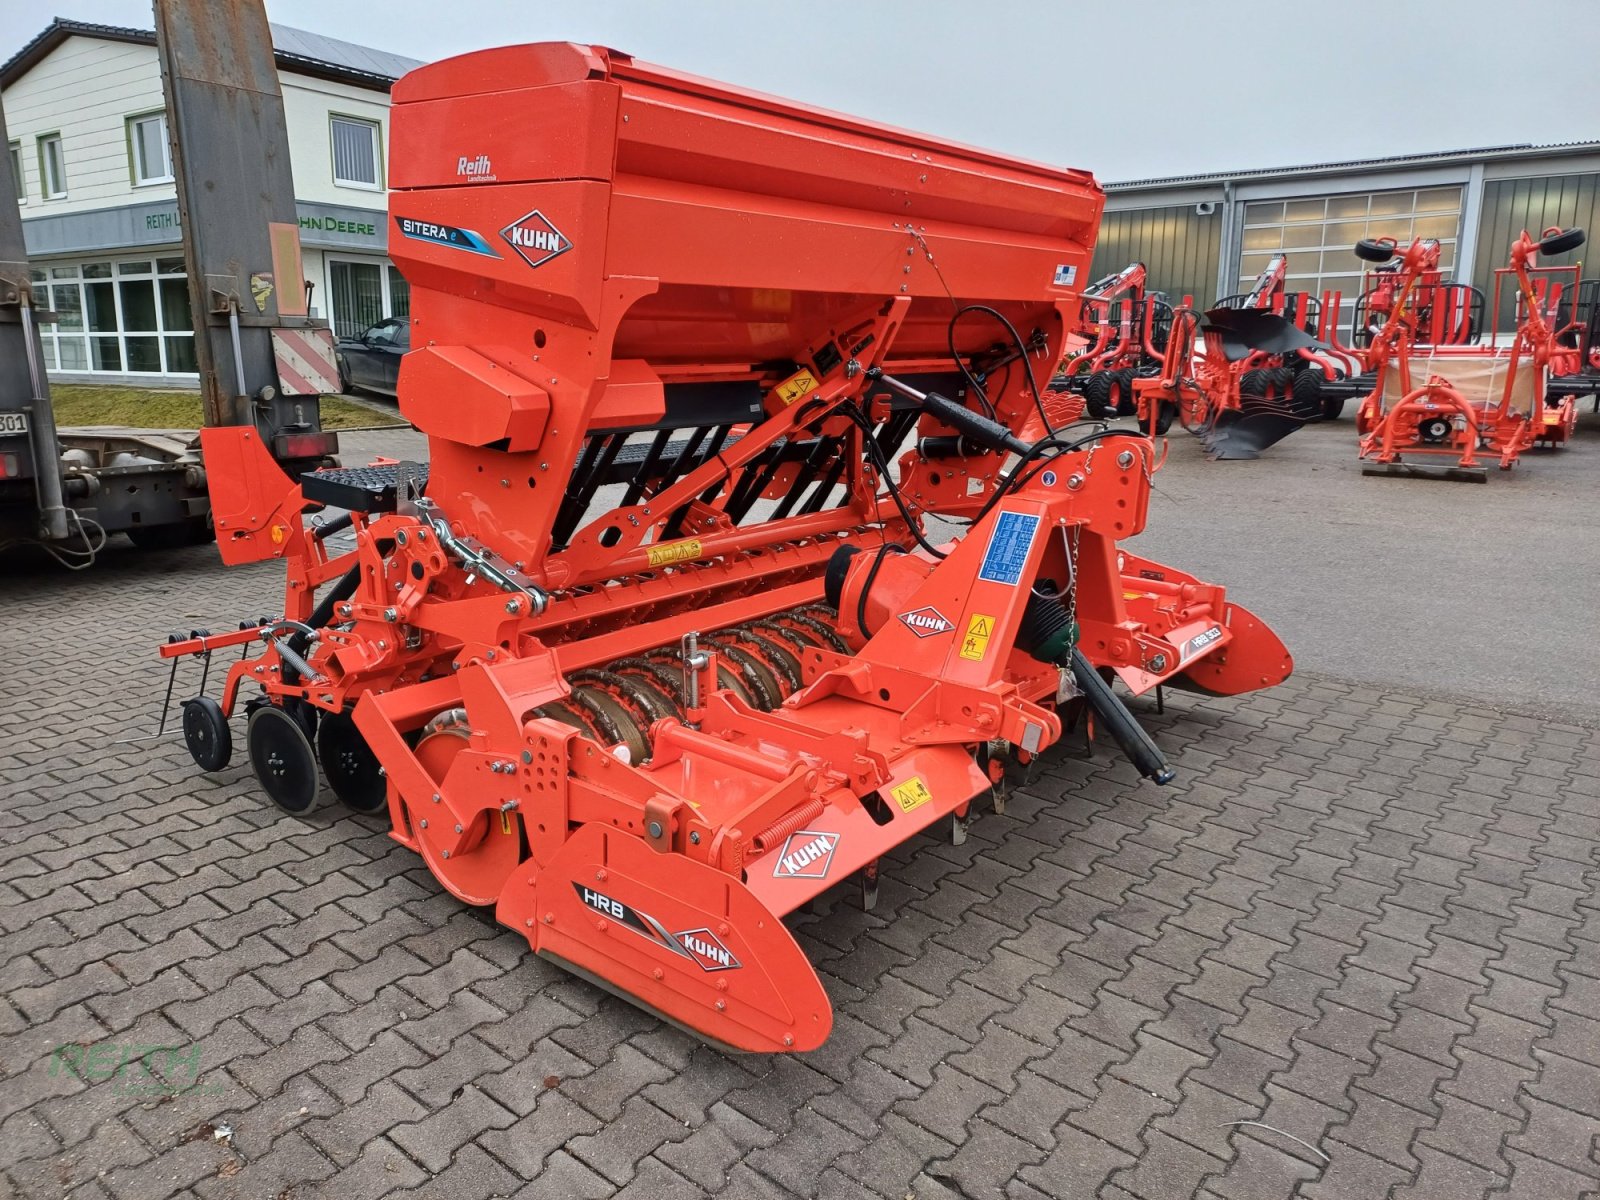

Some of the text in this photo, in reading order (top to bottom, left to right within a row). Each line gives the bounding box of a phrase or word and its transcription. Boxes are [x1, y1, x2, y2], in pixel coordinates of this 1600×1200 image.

[457, 155, 491, 176] Reith
[146, 213, 172, 230] REITH
[325, 216, 375, 236] DEERE
[403, 219, 448, 240] SITERA
[512, 226, 561, 252] KUHN
[906, 613, 948, 632] KUHN
[782, 834, 834, 876] KUHN
[583, 888, 625, 920] HRB
[684, 933, 731, 967] KUHN
